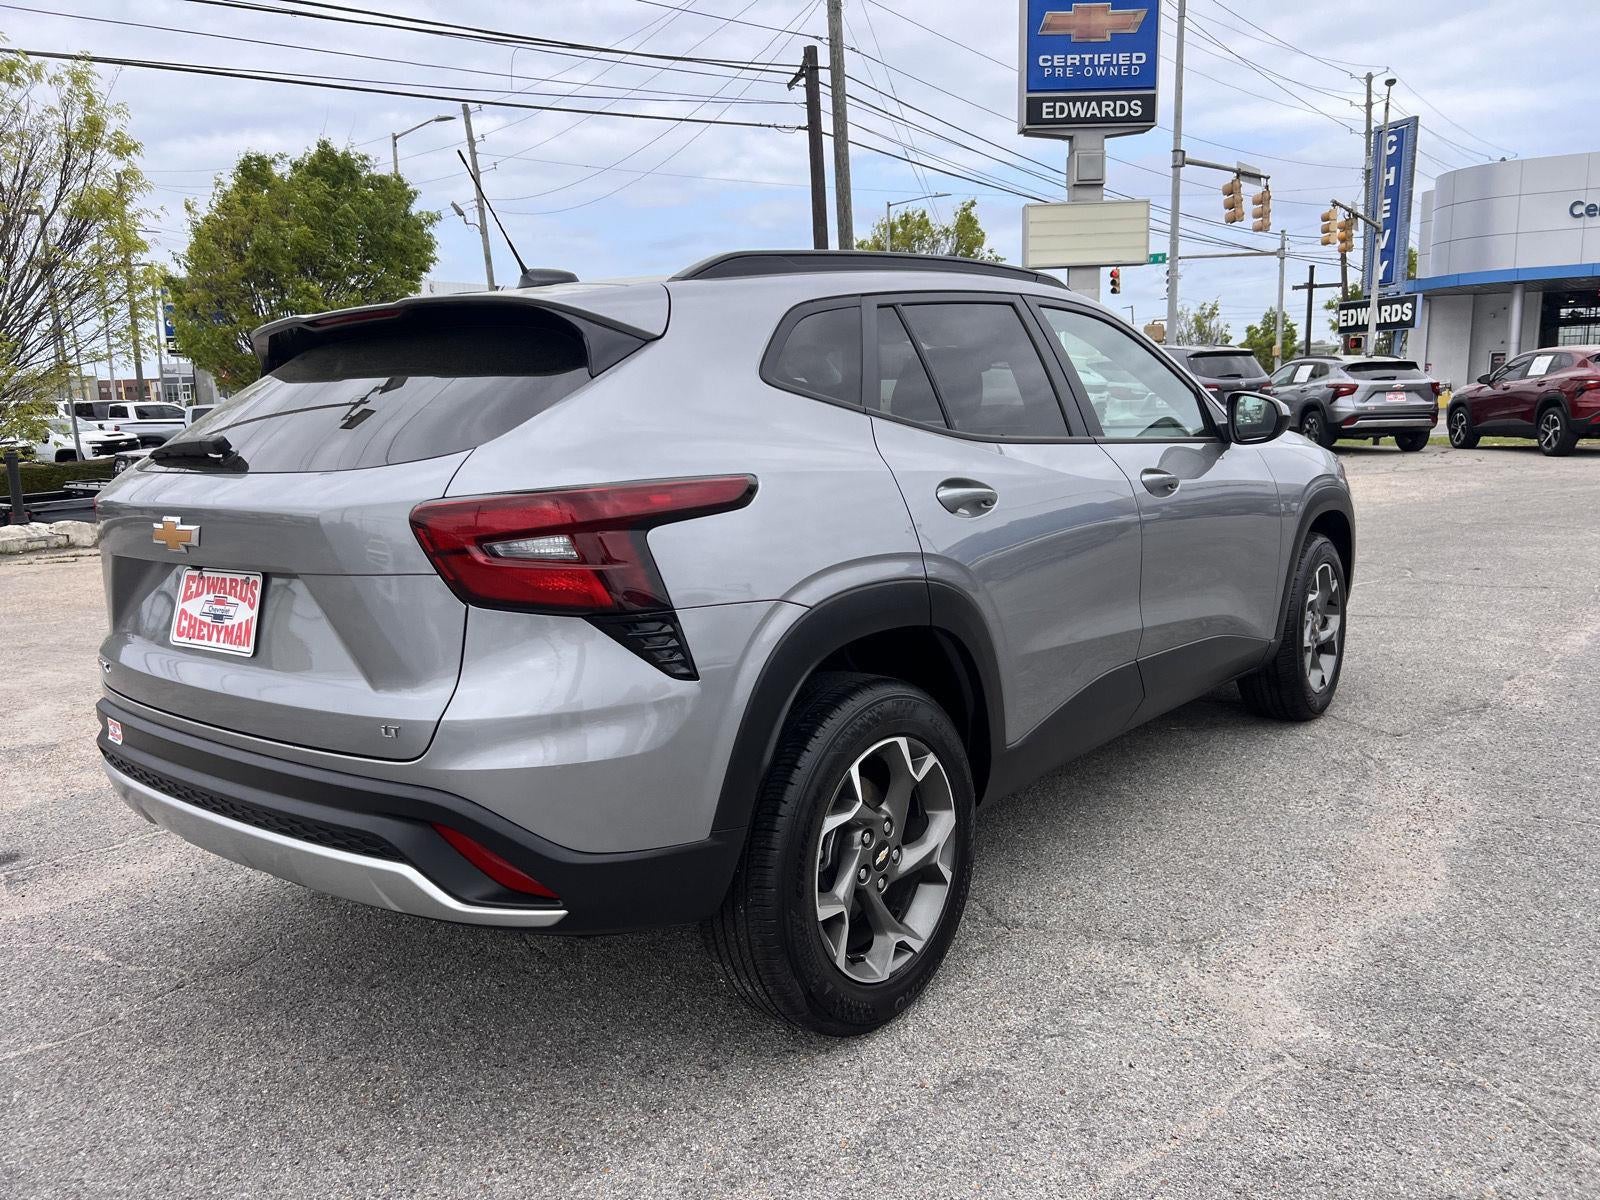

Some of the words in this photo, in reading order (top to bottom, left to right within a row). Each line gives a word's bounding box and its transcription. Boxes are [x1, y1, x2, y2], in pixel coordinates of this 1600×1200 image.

[1039, 53, 1146, 66] CERTIFIED
[1044, 66, 1140, 77] PRE-OWNED
[1042, 100, 1142, 119] EDWARDS
[1569, 200, 1600, 218] Ce
[181, 574, 258, 610] EDWARDS
[176, 608, 254, 647] CHEVYMAN
[380, 725, 399, 738] LT
